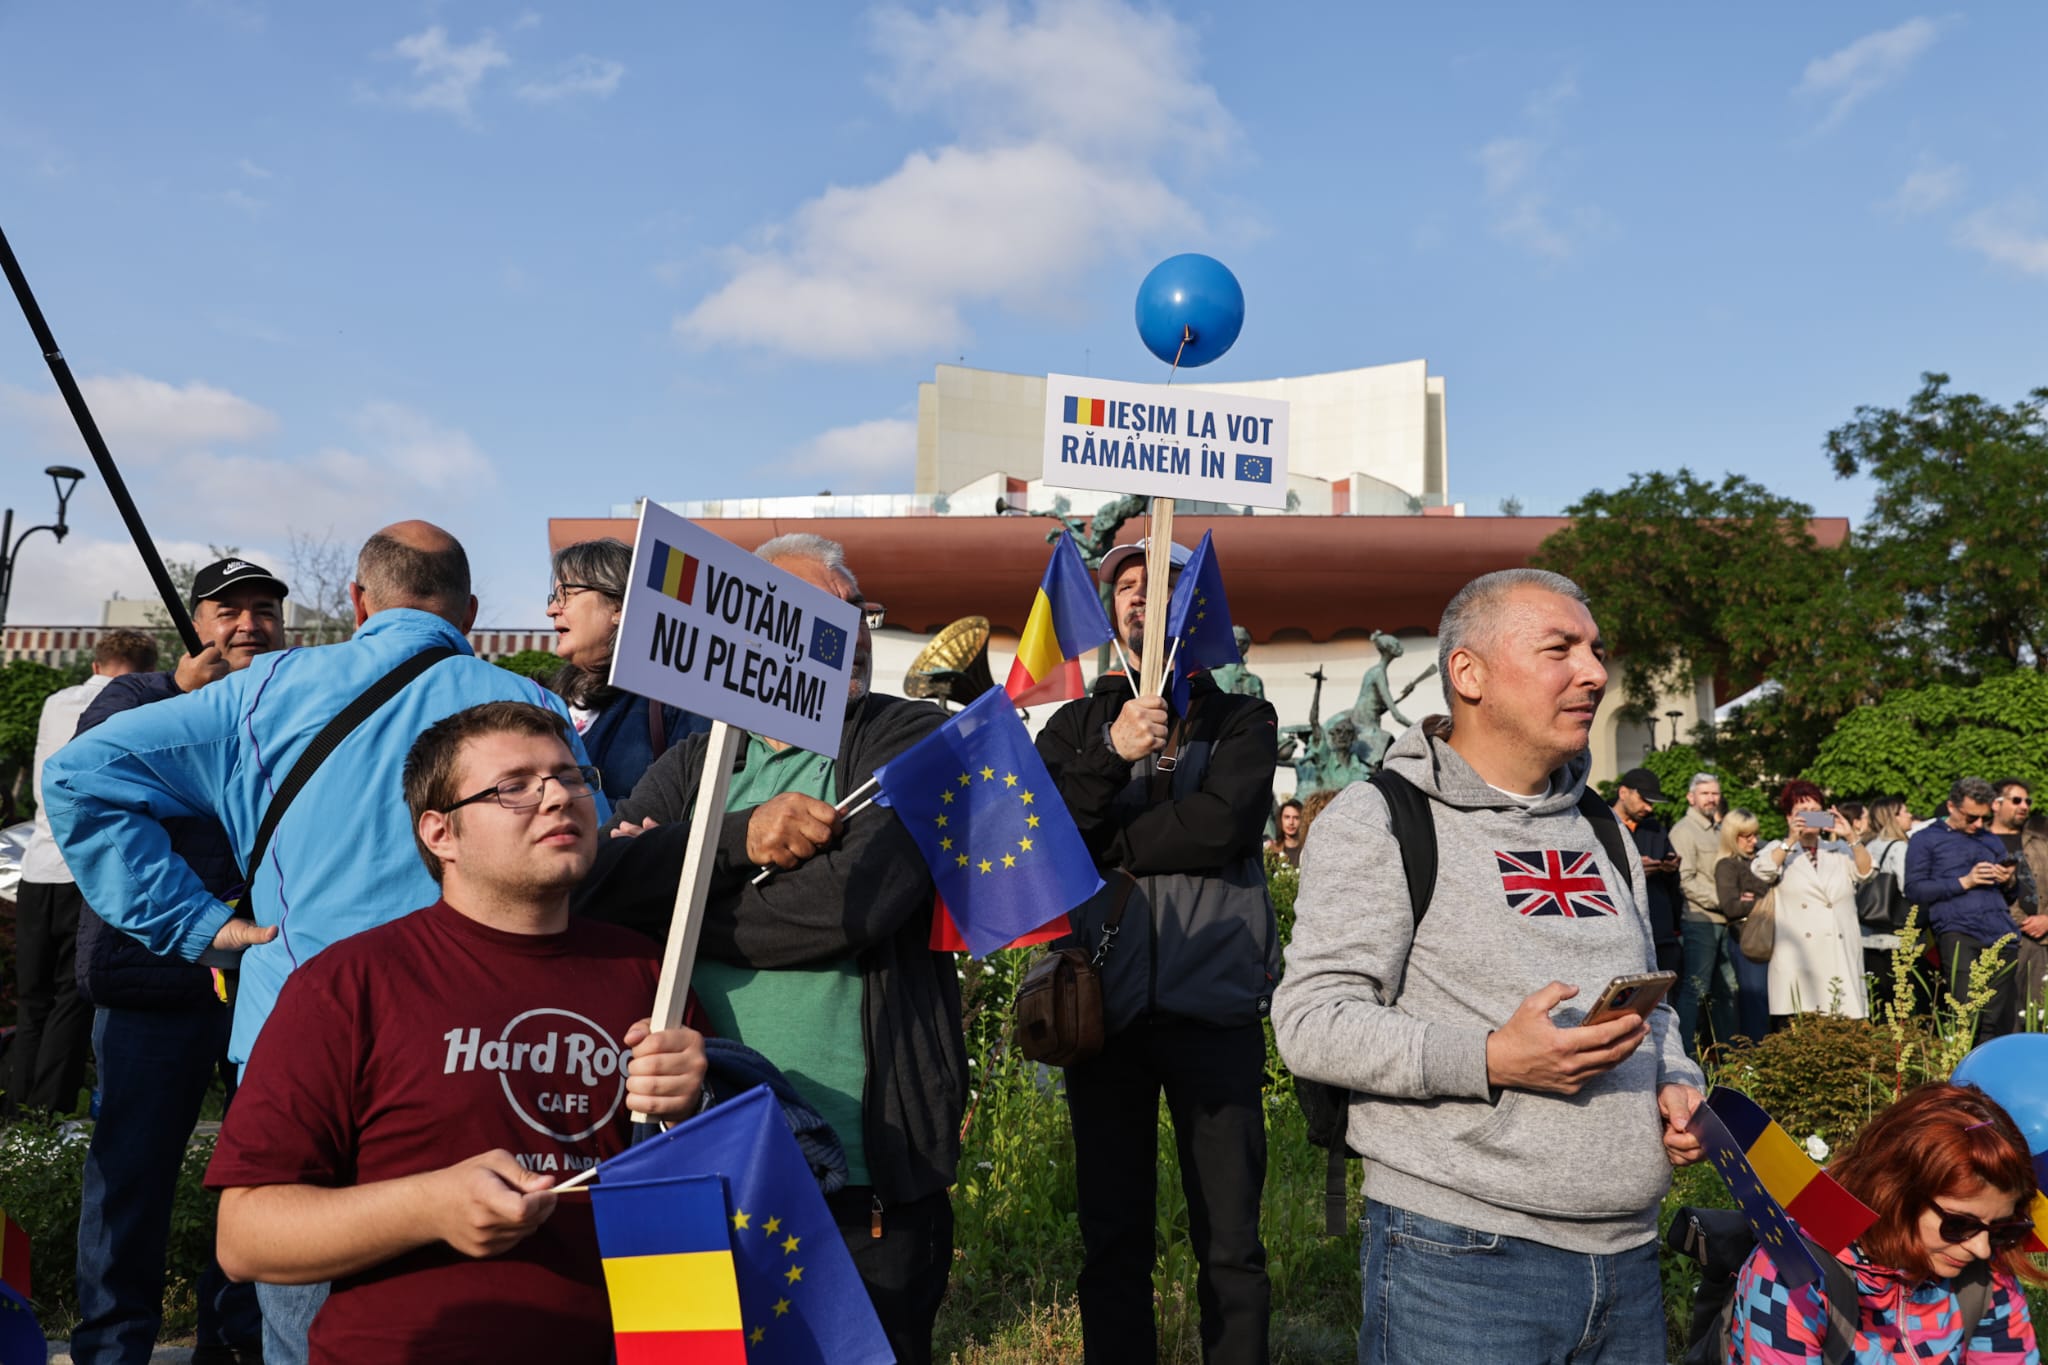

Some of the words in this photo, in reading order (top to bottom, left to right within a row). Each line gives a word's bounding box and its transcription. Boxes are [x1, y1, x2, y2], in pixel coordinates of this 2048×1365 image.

[1108, 399, 1177, 440] IEȘIM
[1187, 409, 1217, 440] LA
[1226, 413, 1274, 446] VOT
[1061, 430, 1191, 476] RĂMÂNEM
[1200, 443, 1225, 479] ÎN
[705, 564, 805, 662] VOTĂM,
[649, 611, 700, 674] NU
[703, 634, 827, 722] PLECĂM!
[443, 1027, 558, 1075] Hard
[564, 1032, 633, 1087] Roc
[537, 1092, 589, 1114] CAFE
